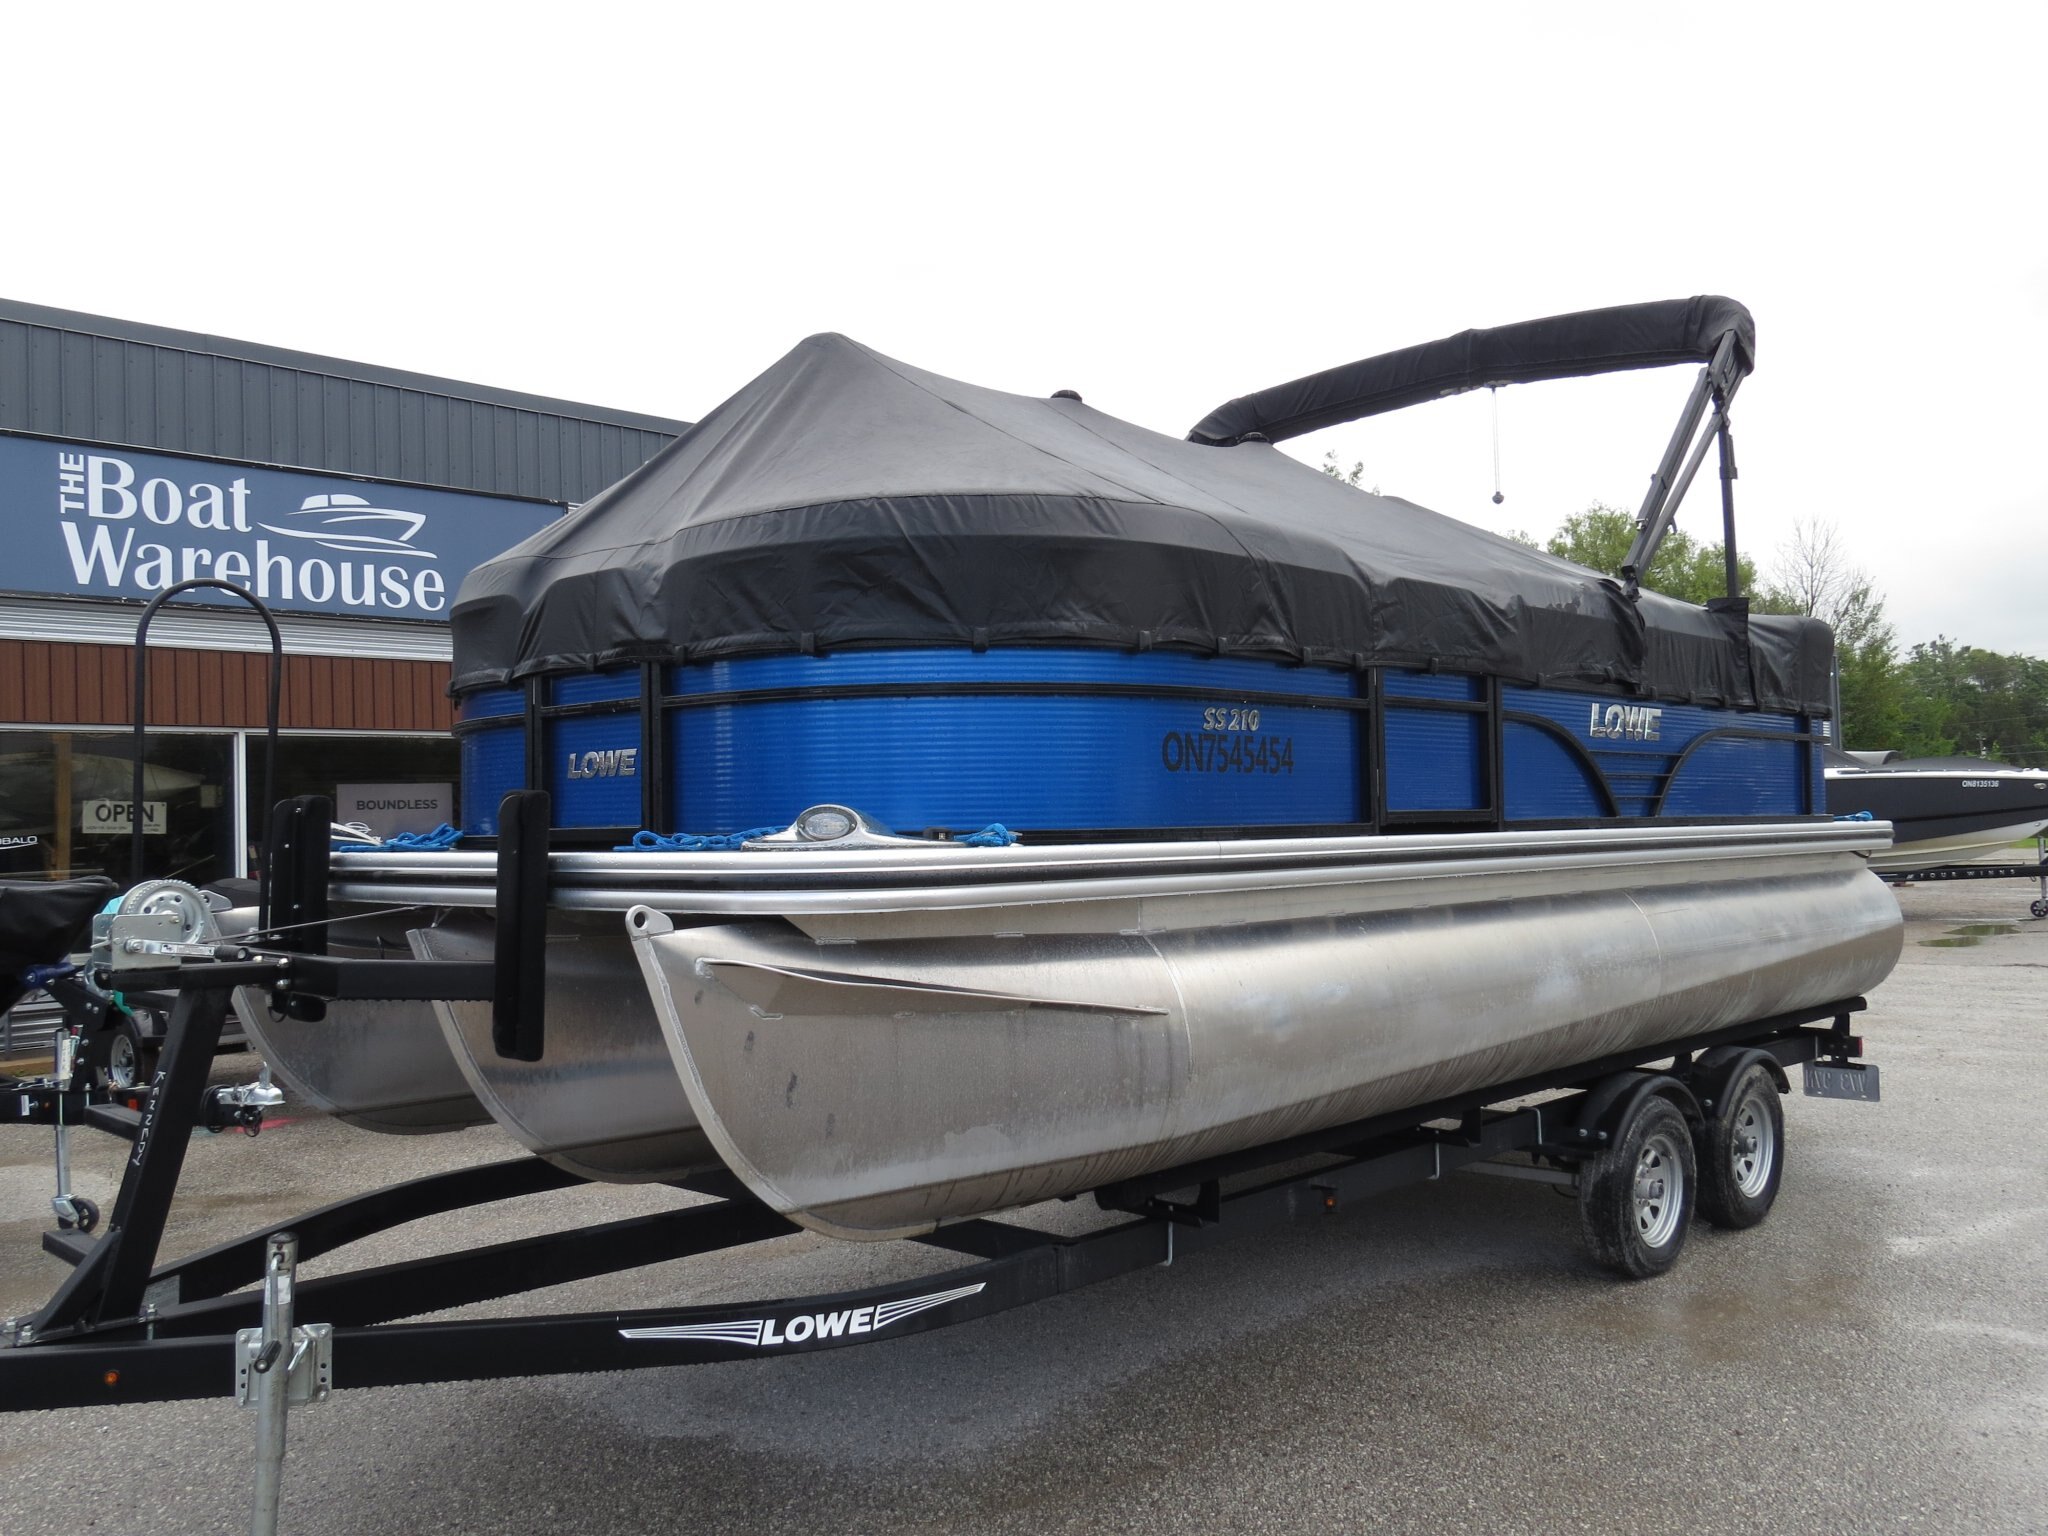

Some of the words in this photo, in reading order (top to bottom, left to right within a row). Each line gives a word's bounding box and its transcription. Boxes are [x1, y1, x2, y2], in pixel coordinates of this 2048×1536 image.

[59, 452, 85, 514] THE
[87, 455, 253, 533] Boat
[60, 521, 446, 612] Warehouse
[1202, 706, 1227, 731] SS
[1228, 708, 1260, 732] 210
[1589, 702, 1662, 741] LOWE
[567, 748, 638, 779] LOWE
[1162, 731, 1295, 775] ON7545454
[356, 799, 438, 811] BOUNDLESS
[0, 835, 38, 845] BALO
[132, 1071, 167, 1166] KENNEDY
[760, 1305, 876, 1346] LOWE
